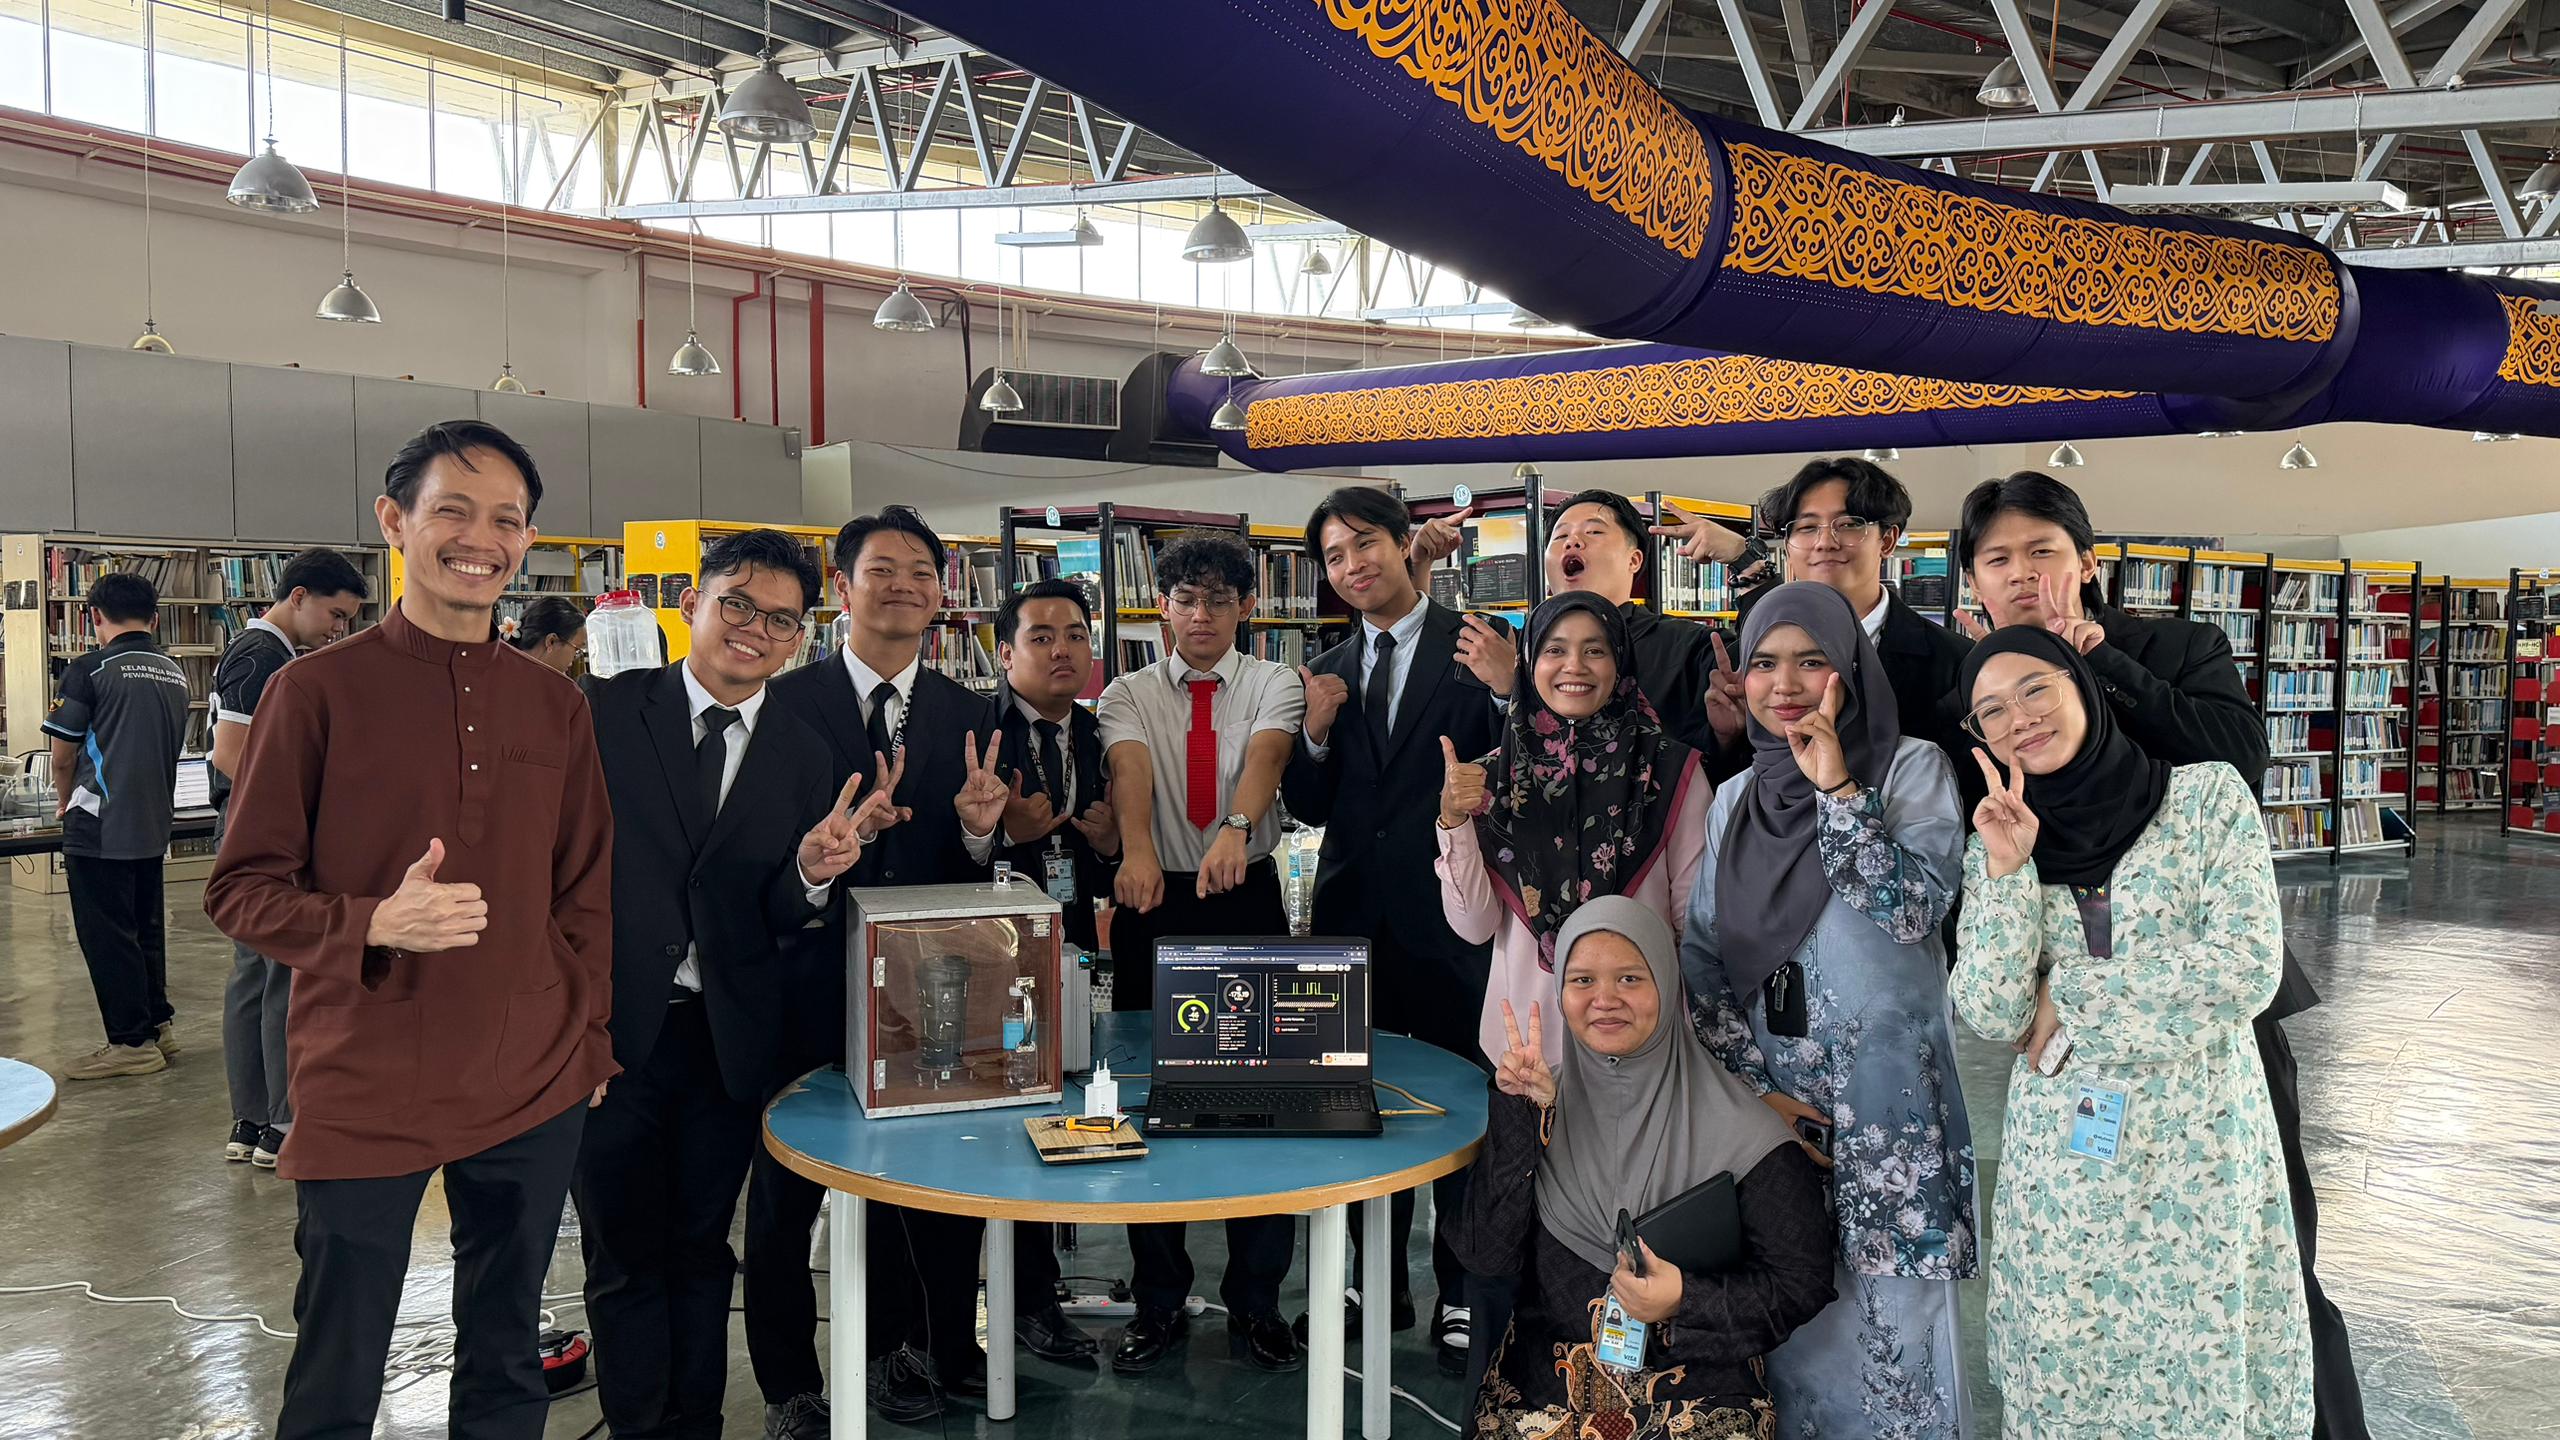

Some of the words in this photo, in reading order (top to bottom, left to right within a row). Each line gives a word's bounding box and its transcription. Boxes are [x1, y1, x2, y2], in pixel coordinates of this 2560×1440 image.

[120, 664, 147, 672] KELAB
[122, 672, 155, 680] PEWARIS
[2097, 1146, 2112, 1155] VISA
